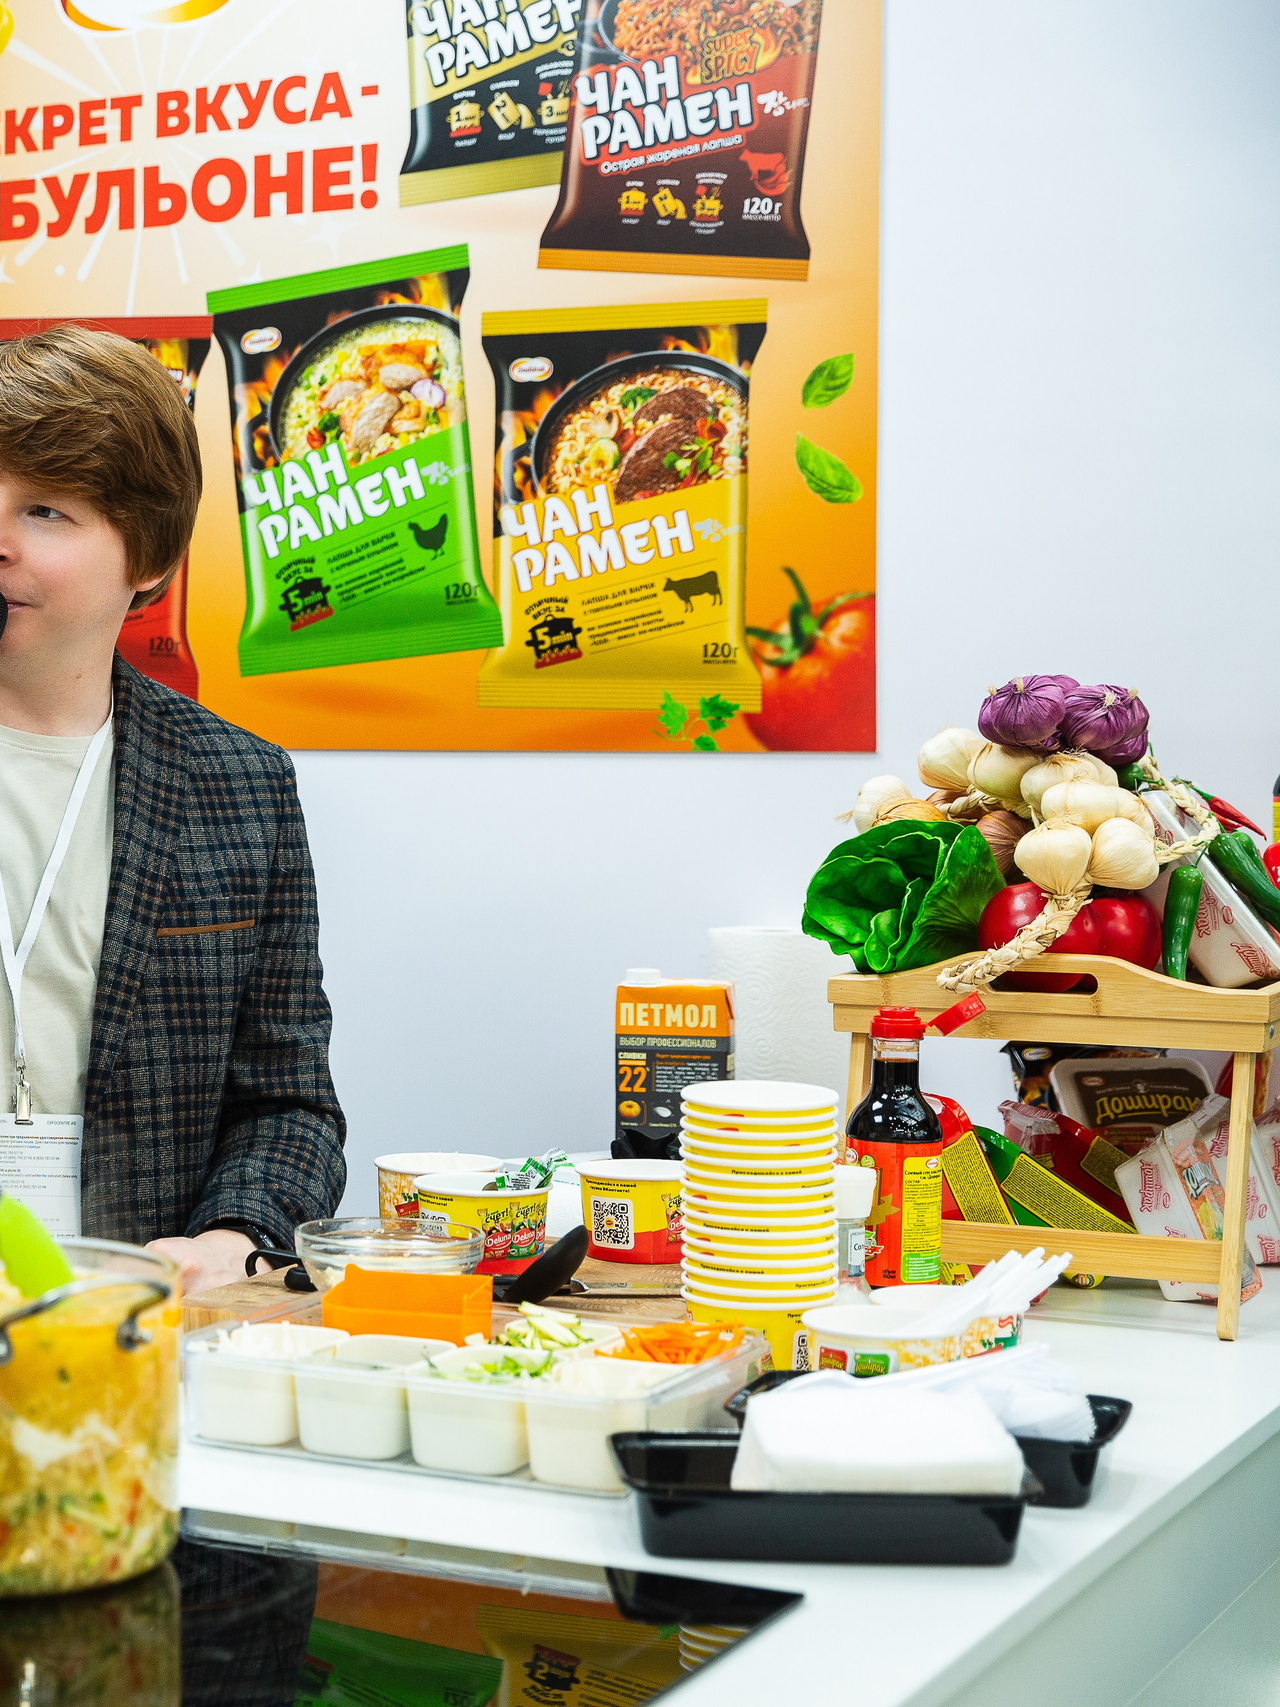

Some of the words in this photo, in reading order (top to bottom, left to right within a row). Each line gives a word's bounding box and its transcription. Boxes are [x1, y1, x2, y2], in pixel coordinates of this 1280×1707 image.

[703, 44, 759, 81] SPICY
[575, 55, 679, 114] ЧАН
[157, 71, 353, 139] ВКУСА
[581, 82, 754, 159] РАМЕН
[601, 156, 645, 174] Острая
[702, 134, 744, 152] лапша
[242, 442, 348, 512] ЧАН
[257, 457, 426, 559] РАМЕН
[500, 483, 613, 546] ЧАН
[512, 509, 695, 592] РАМЕН
[288, 589, 303, 613] 5
[535, 627, 551, 650] 5
[620, 1002, 717, 1029] ПЕТМОЛ
[620, 1037, 647, 1046] ВЫБОР
[618, 1066, 647, 1093] 22
[1096, 1093, 1198, 1124] Доширак
[1138, 1158, 1154, 1213] Доширак
[487, 1233, 512, 1246] Deluna
[514, 1231, 535, 1243] Deluna
